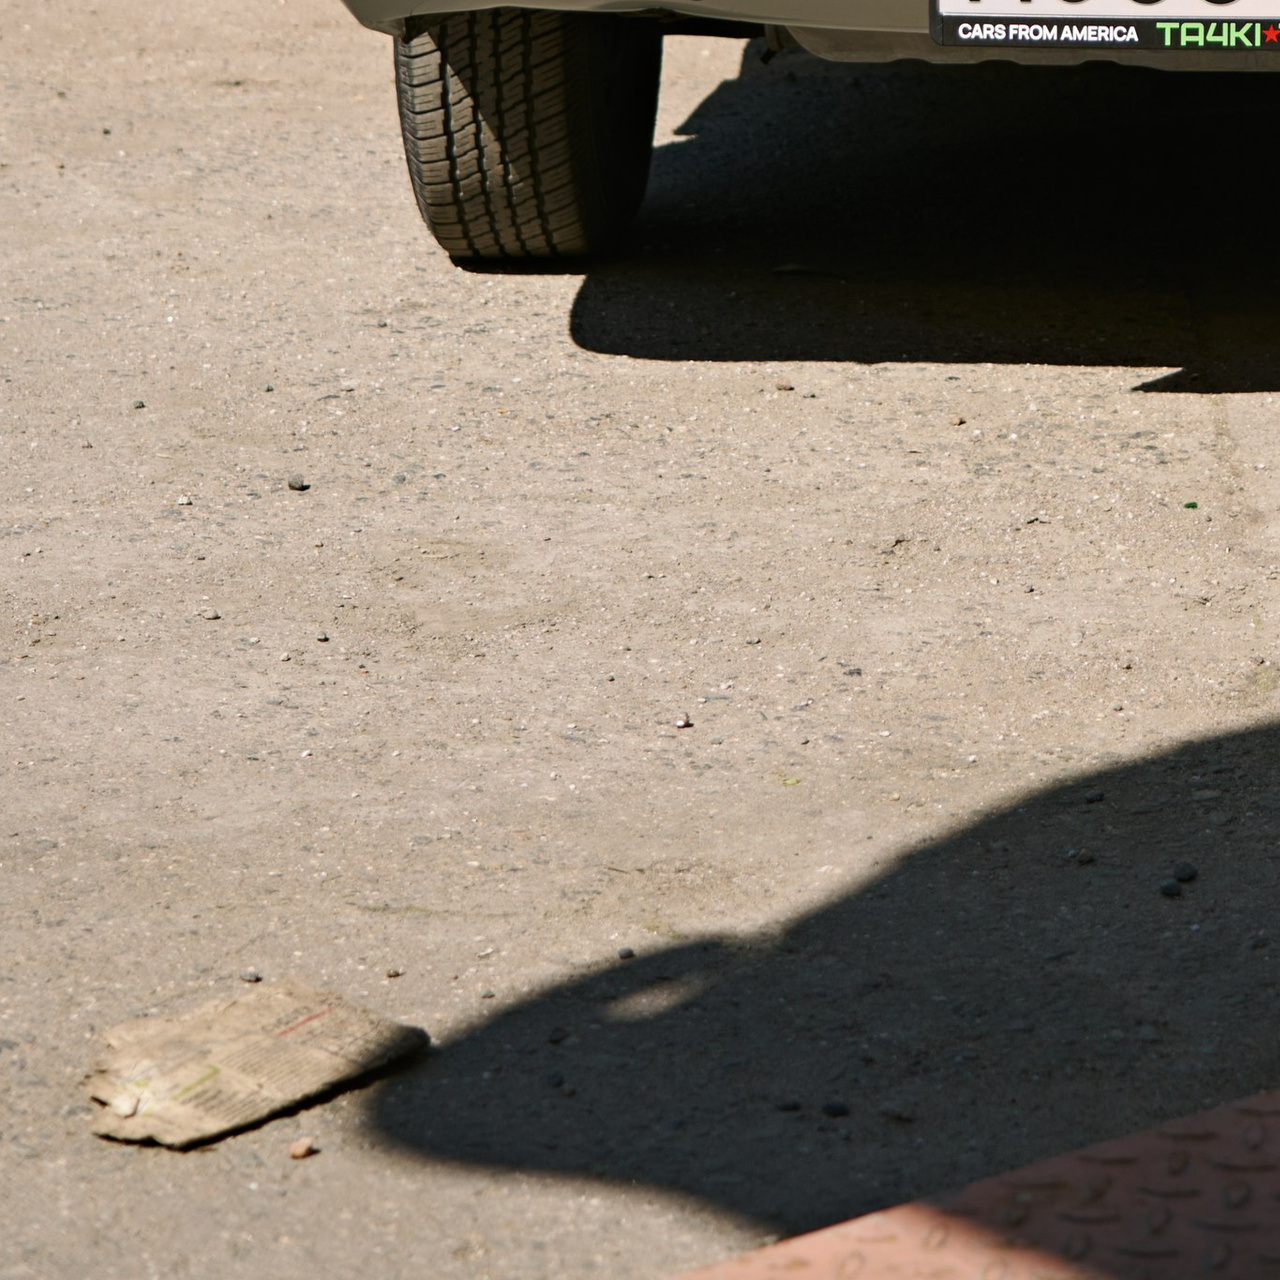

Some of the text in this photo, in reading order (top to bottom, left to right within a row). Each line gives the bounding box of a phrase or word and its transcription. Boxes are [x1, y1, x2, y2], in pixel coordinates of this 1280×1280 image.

[957, 22, 1139, 42] CARS FROM AMERICA
